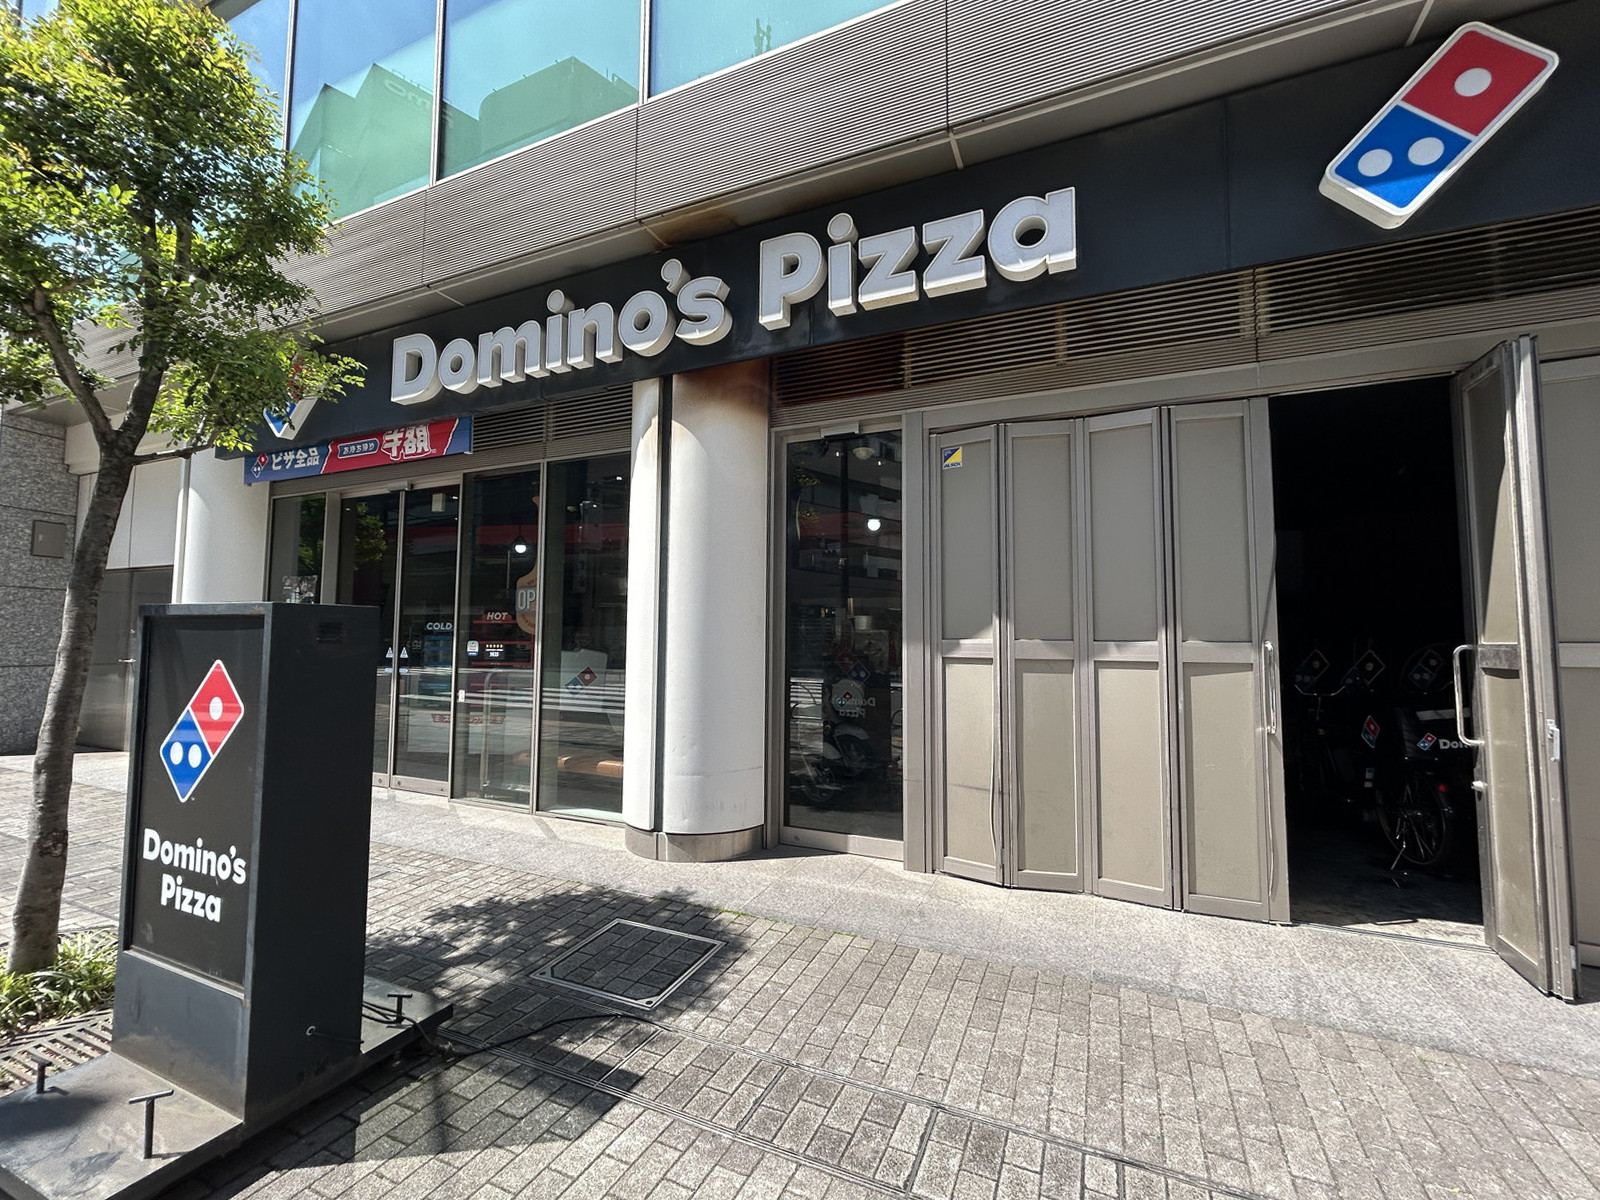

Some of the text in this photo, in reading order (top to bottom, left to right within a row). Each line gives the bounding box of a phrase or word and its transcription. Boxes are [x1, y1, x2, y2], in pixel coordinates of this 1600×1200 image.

[391, 186, 1078, 405] Domino's Pizza
[383, 424, 429, 457] 半額
[486, 612, 508, 621] HOT
[517, 589, 537, 611] OP
[426, 621, 453, 630] COLD
[142, 827, 248, 885] Domino's
[160, 873, 222, 922] Pizza
